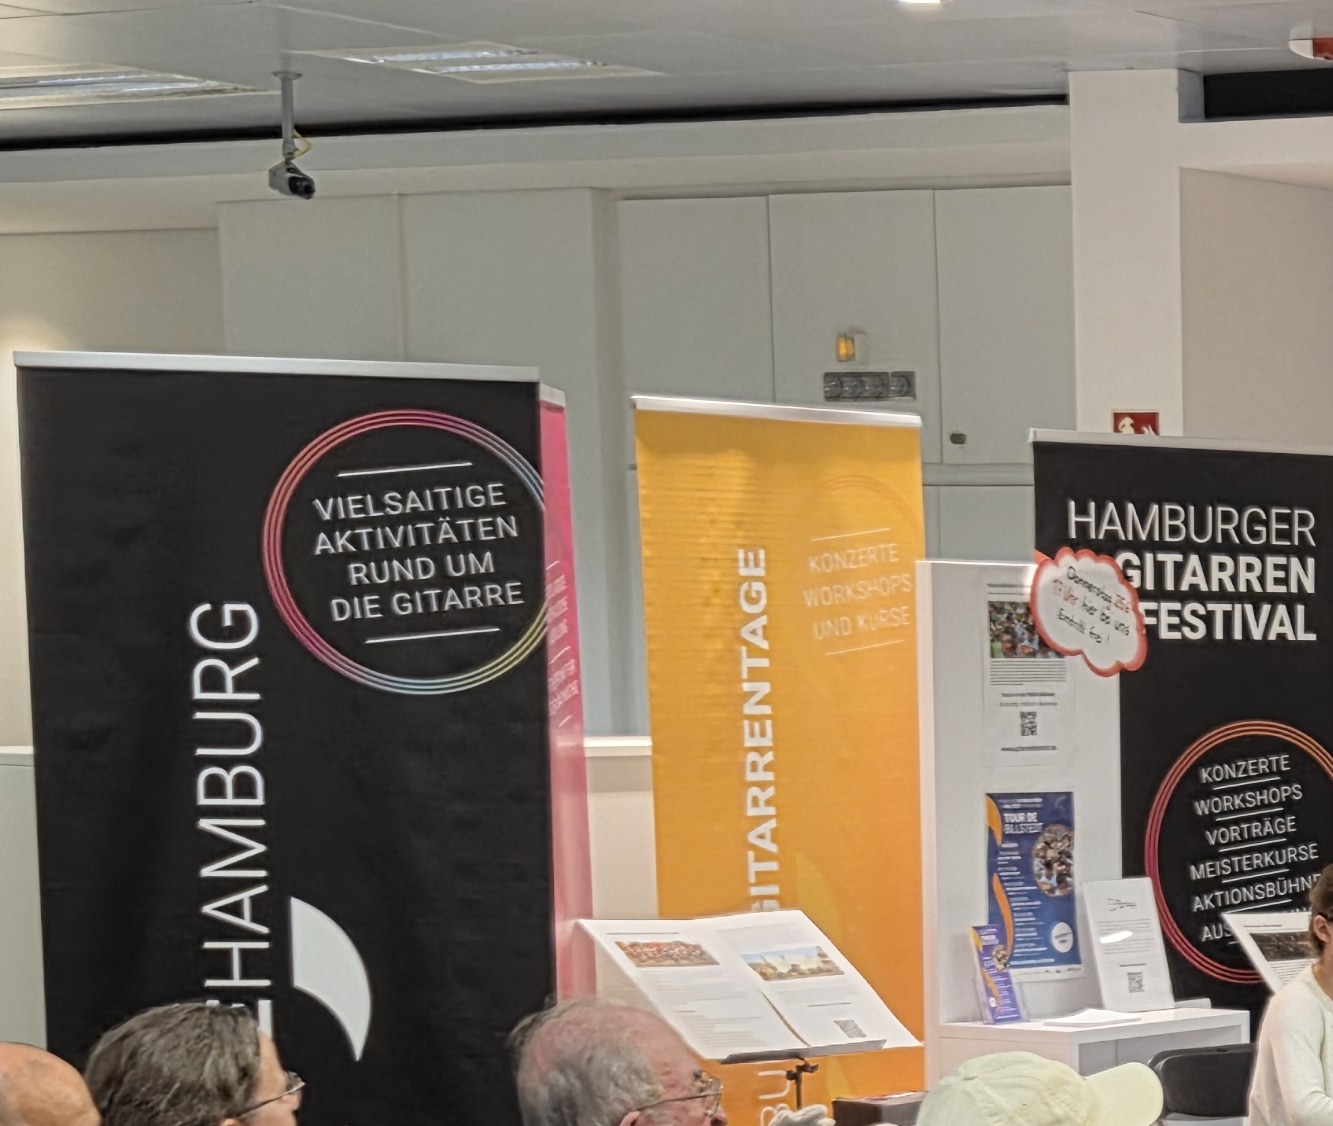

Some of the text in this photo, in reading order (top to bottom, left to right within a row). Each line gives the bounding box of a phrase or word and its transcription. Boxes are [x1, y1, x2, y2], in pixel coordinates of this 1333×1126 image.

[312, 483, 507, 521] VIELSAITIGE
[313, 515, 519, 556] AKTIVITÄTEN
[1067, 500, 1316, 547] HAMBURGER
[347, 551, 495, 586] RUND UM
[808, 543, 899, 573] KONZERTE
[1115, 552, 1315, 594] GITARREN
[330, 595, 383, 622] DIE
[391, 582, 524, 616] GITARRE
[803, 573, 912, 608] WORKSHOPS
[813, 605, 911, 640] UND KURSE
[1136, 602, 1317, 641] FESTIVAL
[1200, 754, 1291, 784] KONZERTE
[189, 602, 271, 987] HAMBURG
[1193, 784, 1303, 816] WORKSHOPS
[1205, 815, 1297, 846] VORTRÄGE
[1190, 843, 1319, 881] MEISTERKURSE
